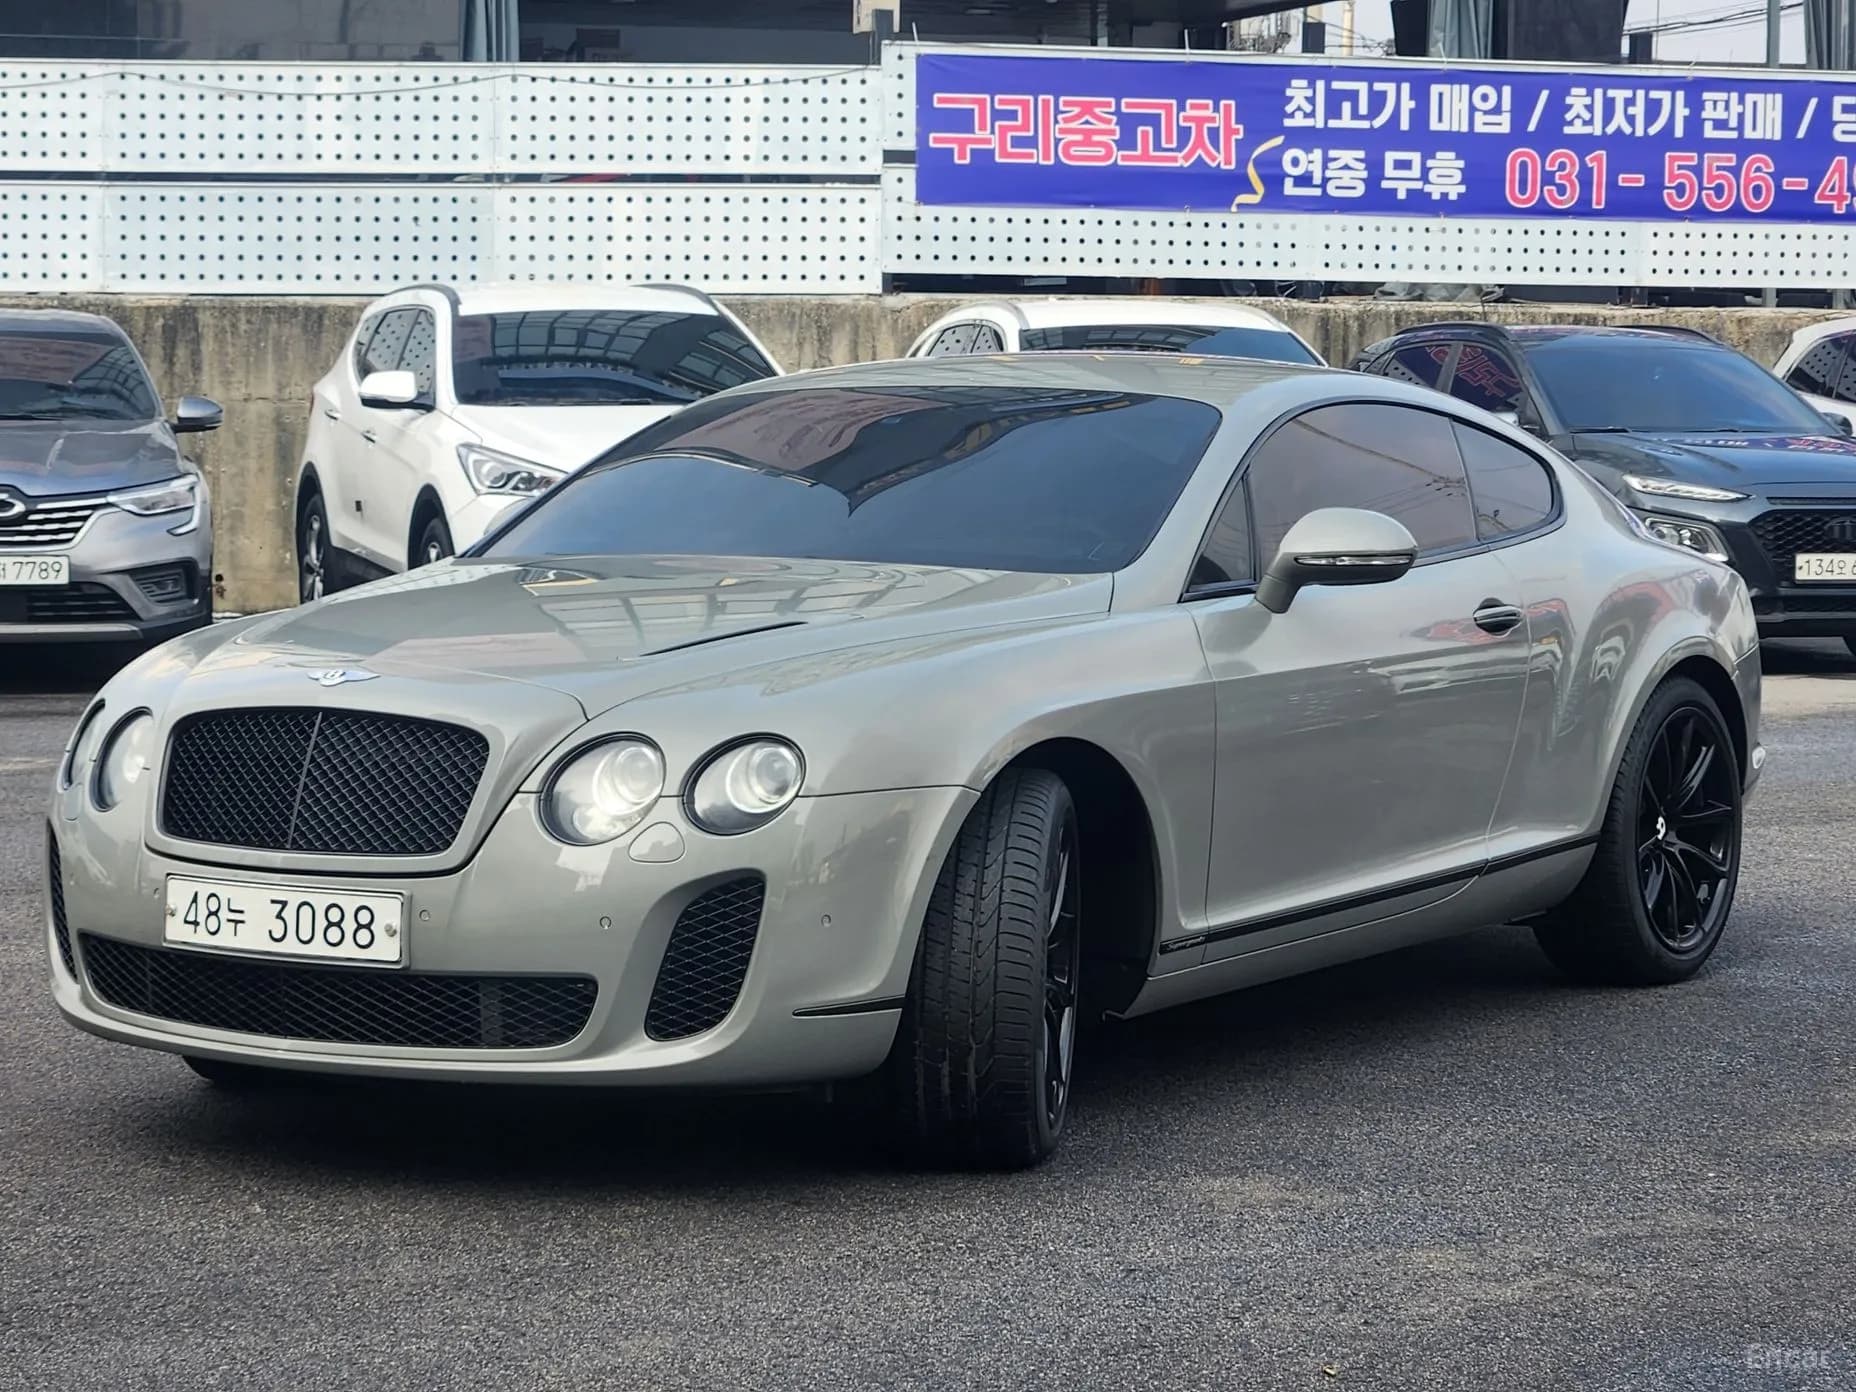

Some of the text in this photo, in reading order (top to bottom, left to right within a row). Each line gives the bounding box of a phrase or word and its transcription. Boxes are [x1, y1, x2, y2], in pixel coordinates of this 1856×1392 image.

[929, 93, 1244, 169] 구리중고차
[1283, 79, 1416, 131] 최고가
[1429, 83, 1512, 134] 매입
[1562, 87, 1690, 138] 최저가
[1701, 91, 1783, 141] 판매
[1282, 148, 1466, 200] 연중 무휴
[183, 890, 375, 950] 48누 3088
